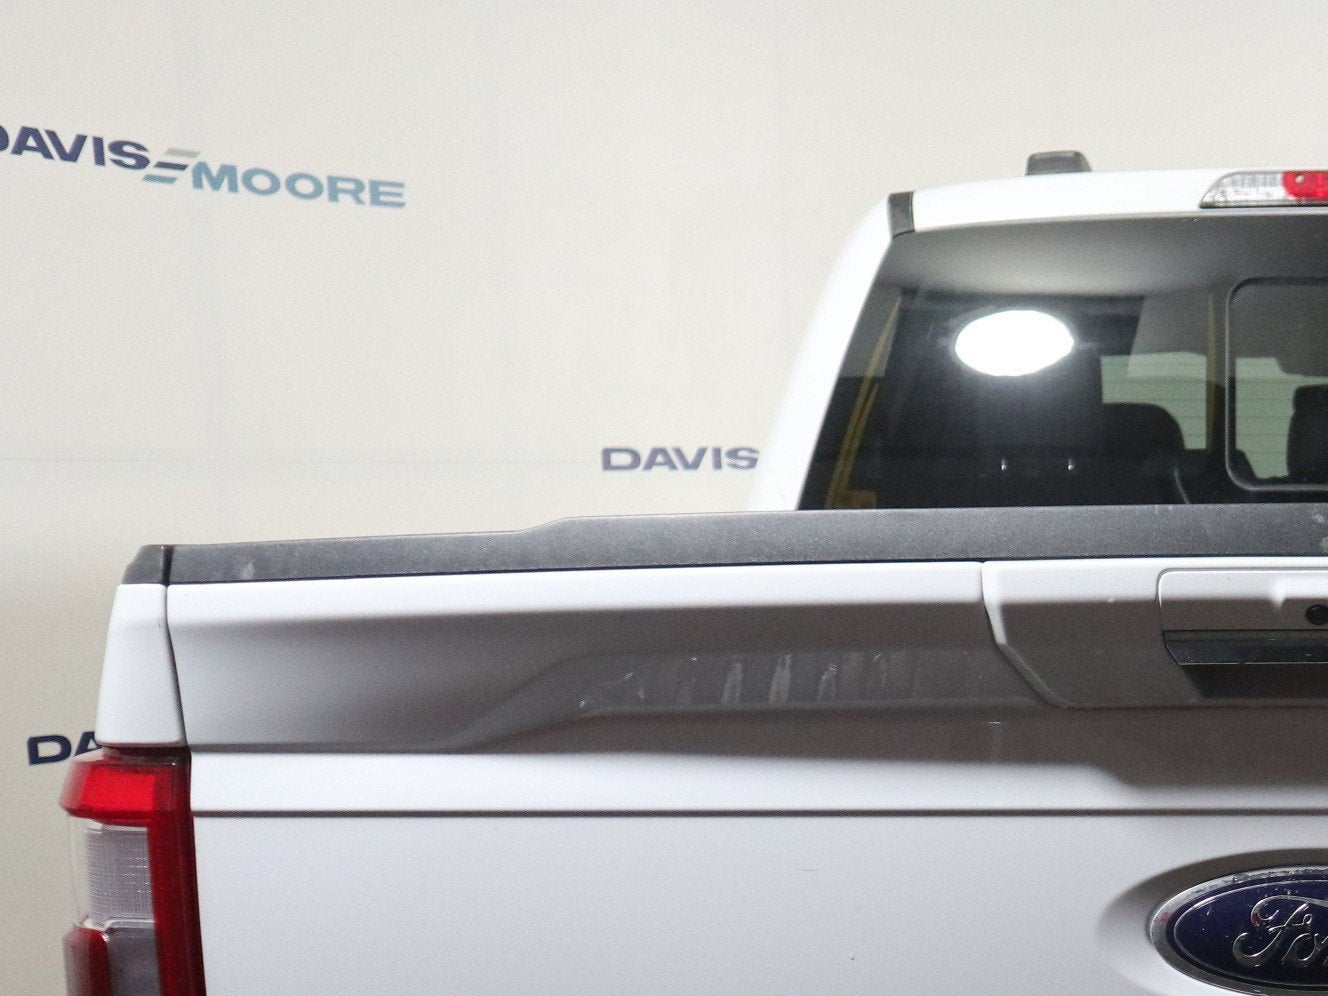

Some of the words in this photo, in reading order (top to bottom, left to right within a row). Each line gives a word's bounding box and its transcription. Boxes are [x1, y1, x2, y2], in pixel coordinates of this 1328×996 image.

[0, 125, 151, 171] AVIS
[191, 161, 406, 208] MOORE
[602, 447, 760, 471] DAVIS
